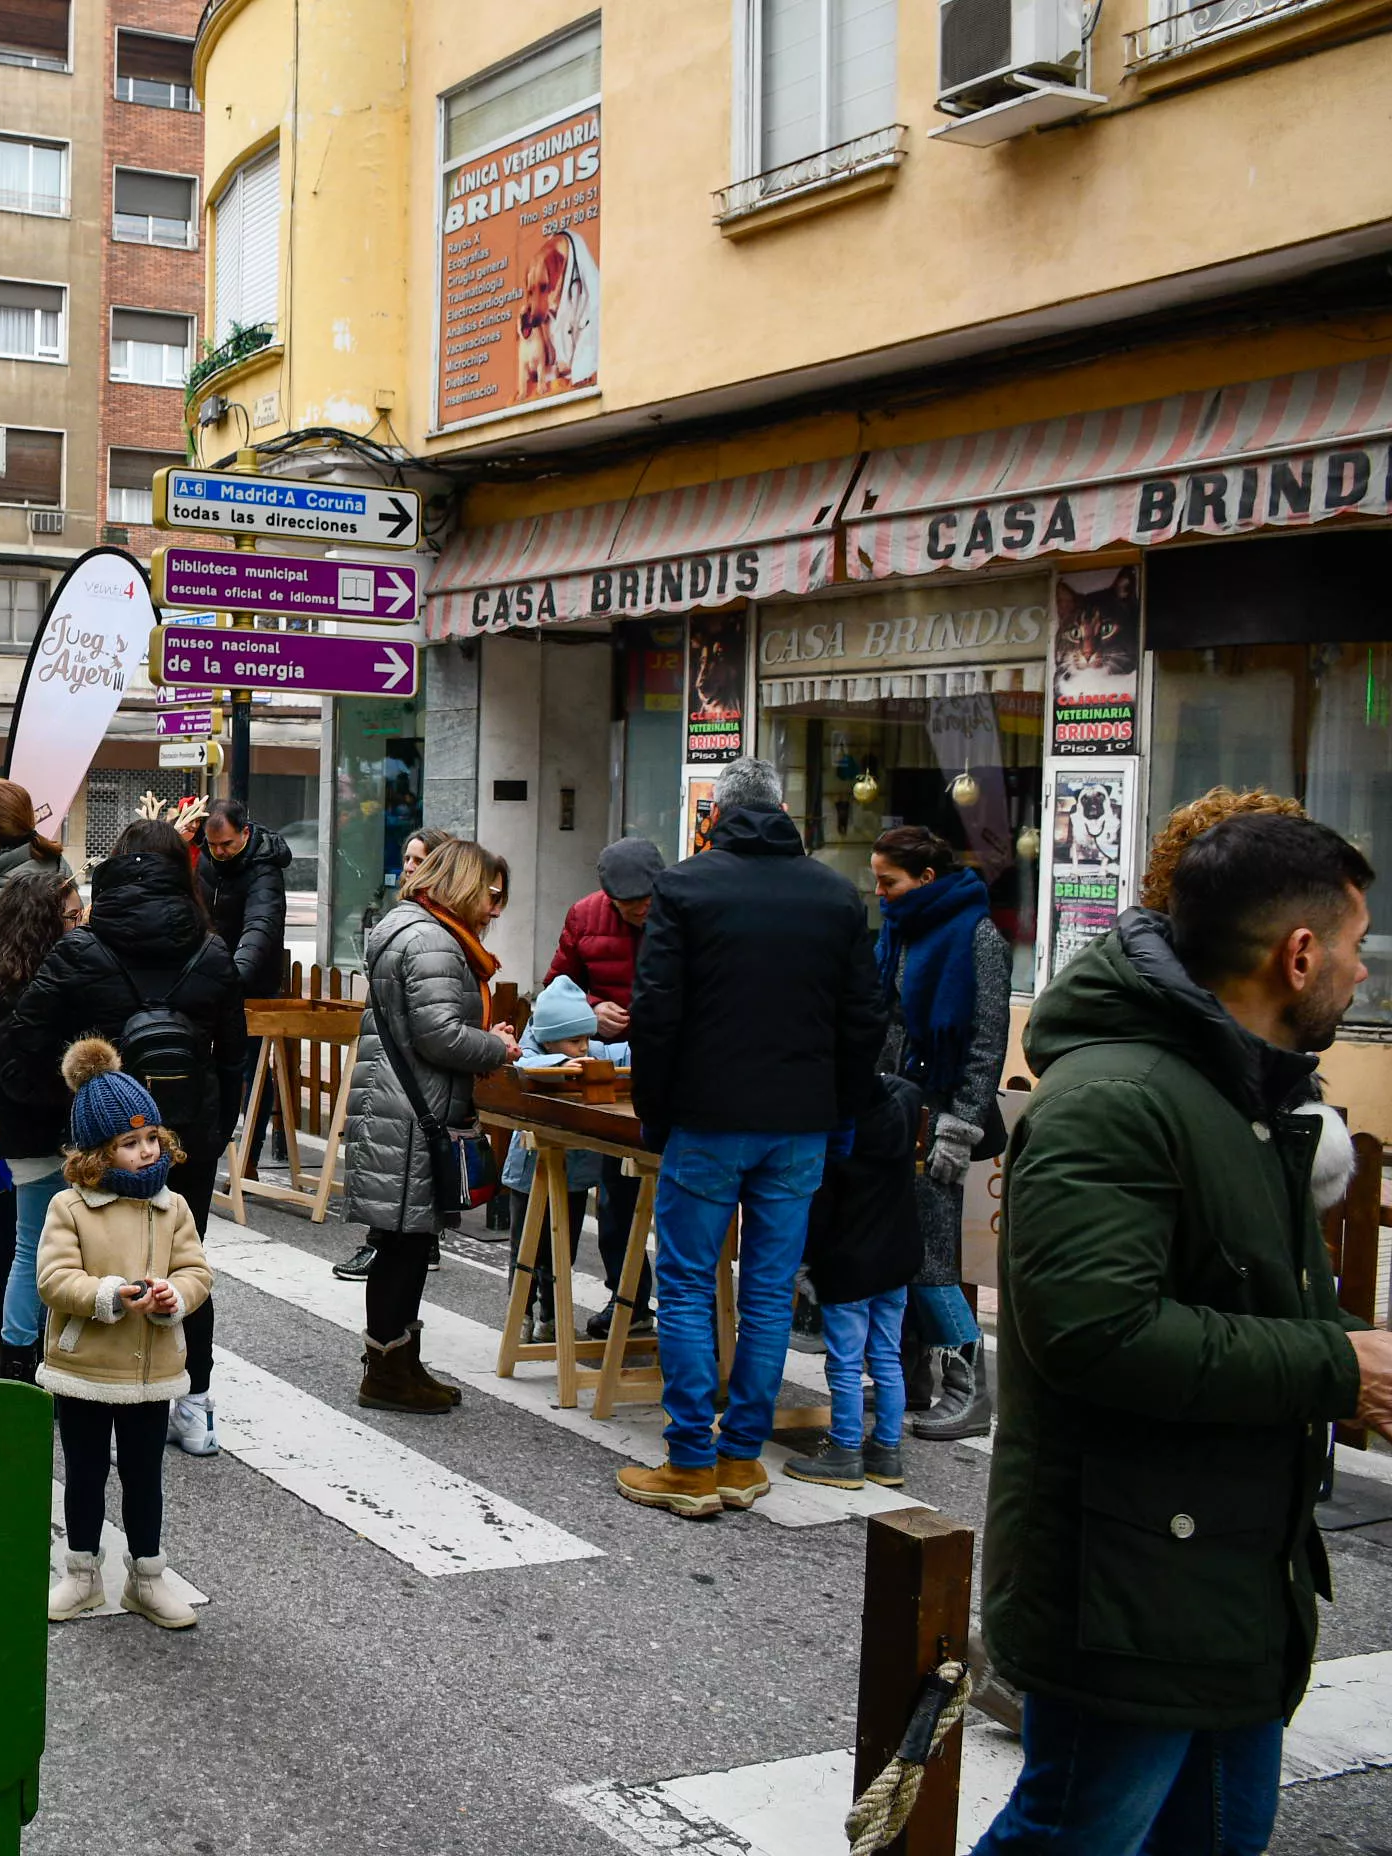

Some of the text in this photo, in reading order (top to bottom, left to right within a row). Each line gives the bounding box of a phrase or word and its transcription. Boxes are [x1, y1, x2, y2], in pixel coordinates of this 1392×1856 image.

[450, 118, 600, 200] LÍNICA VETERINARIA
[444, 147, 600, 234] BRINDIS
[543, 203, 558, 218] 987
[560, 198, 571, 210] 41
[587, 187, 598, 200] 51
[587, 205, 598, 218] 62
[448, 232, 480, 255] Rayos X
[477, 256, 509, 279] general
[446, 329, 501, 356] Vacunaciones
[445, 351, 489, 373] Microchips
[178, 482, 364, 512] A-6 Madrid-A Coruña
[173, 503, 358, 534] todas las direcciones
[927, 496, 1076, 561] CASA
[172, 559, 308, 582] biblioteca municipal
[171, 584, 335, 605] escuela oficial de idiomas
[472, 550, 760, 627] CASA BRINDIS
[168, 637, 280, 654] museo nacional
[760, 606, 1046, 665] CASA BRINDIS
[74, 650, 88, 663] de
[168, 654, 305, 682] de la energía
[39, 648, 113, 694] Ayer
[1056, 707, 1131, 720] VETERINARIA
[689, 722, 739, 733] VETERINARIA
[1056, 721, 1133, 742] BRINDIS
[689, 734, 741, 750] BRINDIS
[1055, 883, 1117, 899] BRINDIS
